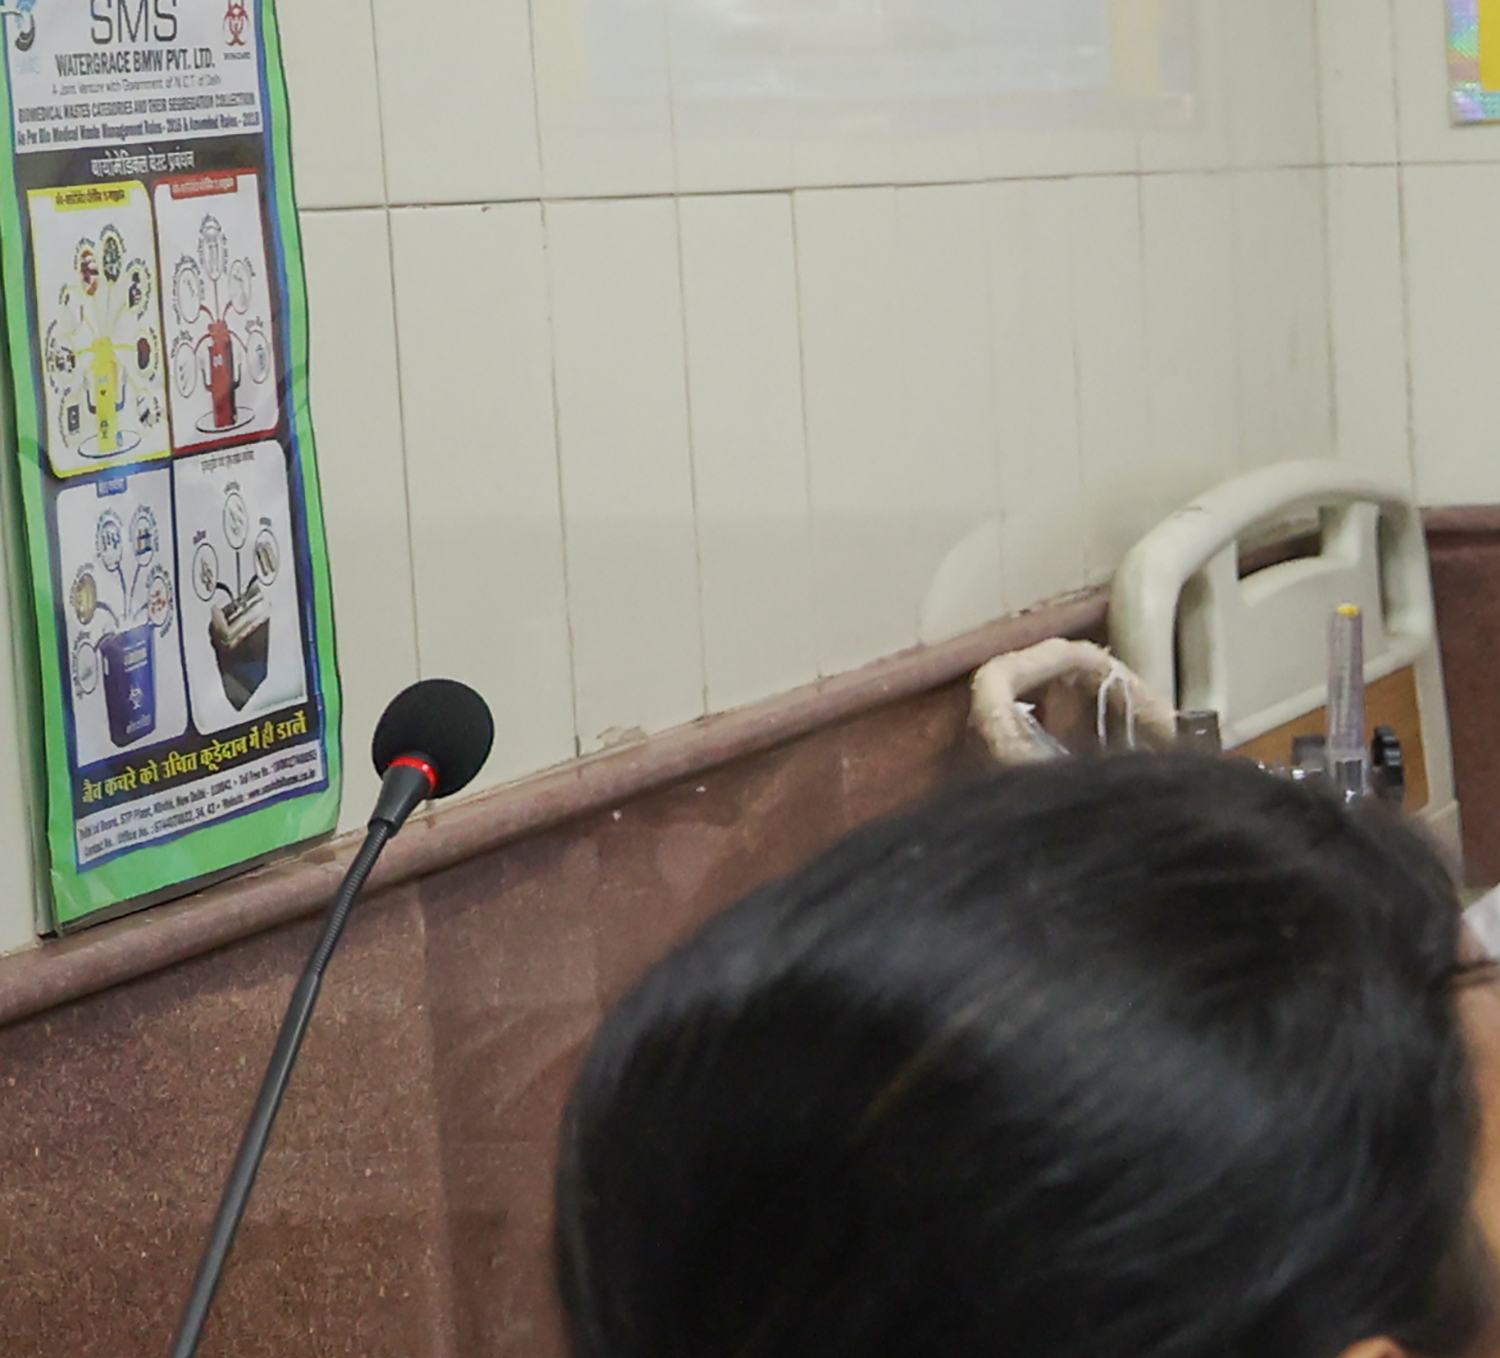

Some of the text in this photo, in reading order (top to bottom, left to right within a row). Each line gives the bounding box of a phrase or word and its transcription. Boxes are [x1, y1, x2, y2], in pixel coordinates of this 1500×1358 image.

[55, 52, 132, 77] WATERGRACE
[133, 50, 164, 73] BMW
[166, 49, 192, 70] PVT.
[194, 47, 216, 69] LTD.
[104, 766, 138, 797] कचरे
[139, 760, 159, 785] को
[162, 751, 198, 779] उचित
[249, 725, 261, 750] में
[261, 721, 275, 750] ही
[276, 709, 308, 739] डालें
